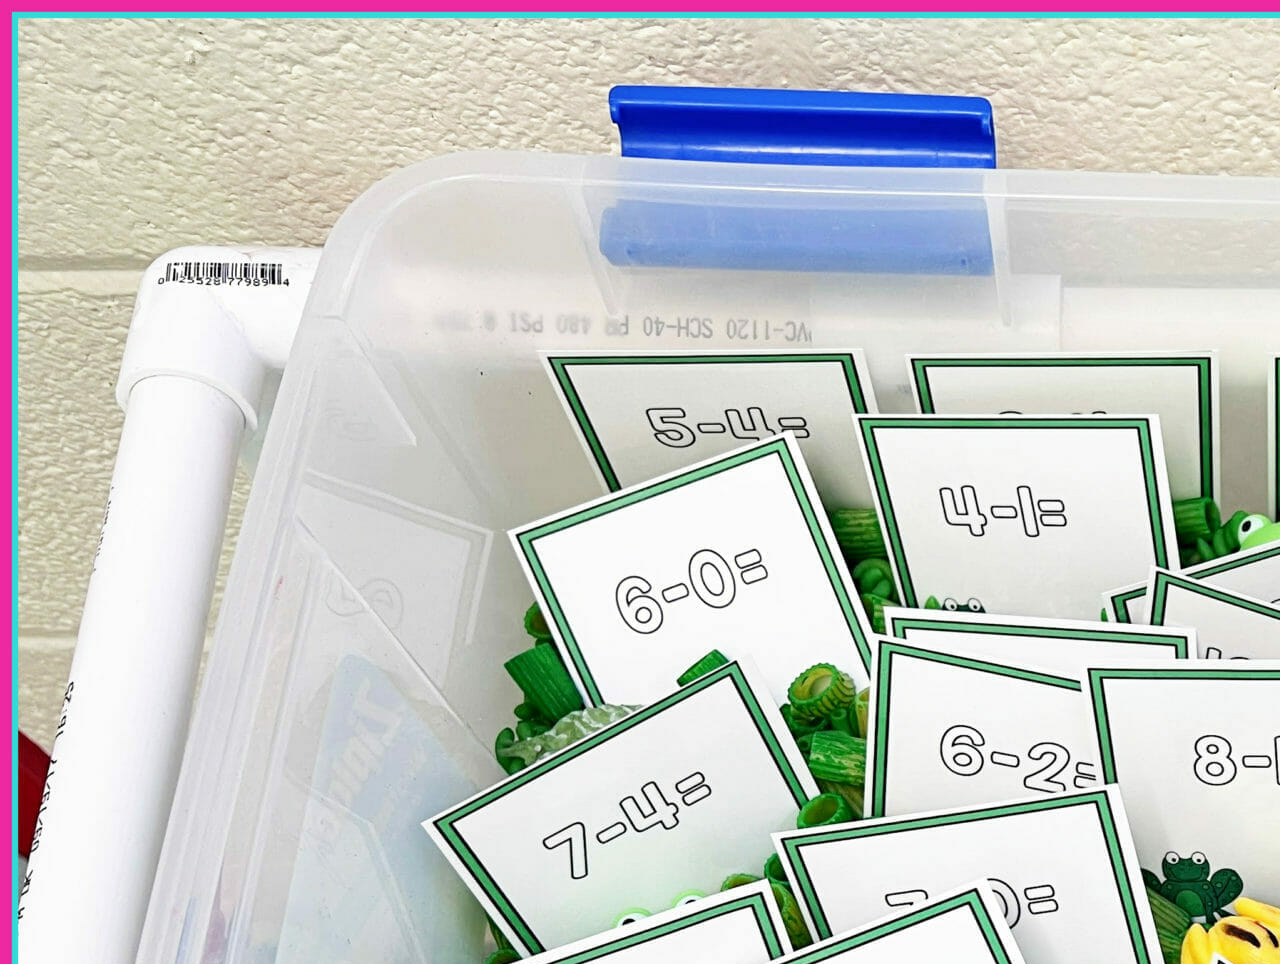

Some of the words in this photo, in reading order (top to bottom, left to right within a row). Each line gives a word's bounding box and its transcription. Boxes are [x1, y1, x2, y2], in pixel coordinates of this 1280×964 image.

[283, 278, 290, 287] 4
[642, 315, 714, 339] SCH-40
[726, 317, 813, 343] VC-1120
[645, 406, 811, 449] 5-4=
[938, 484, 1068, 538] 4-1=
[615, 548, 769, 635] 6-0=
[939, 724, 1098, 793] 6-2=
[542, 771, 713, 880] 7-4=
